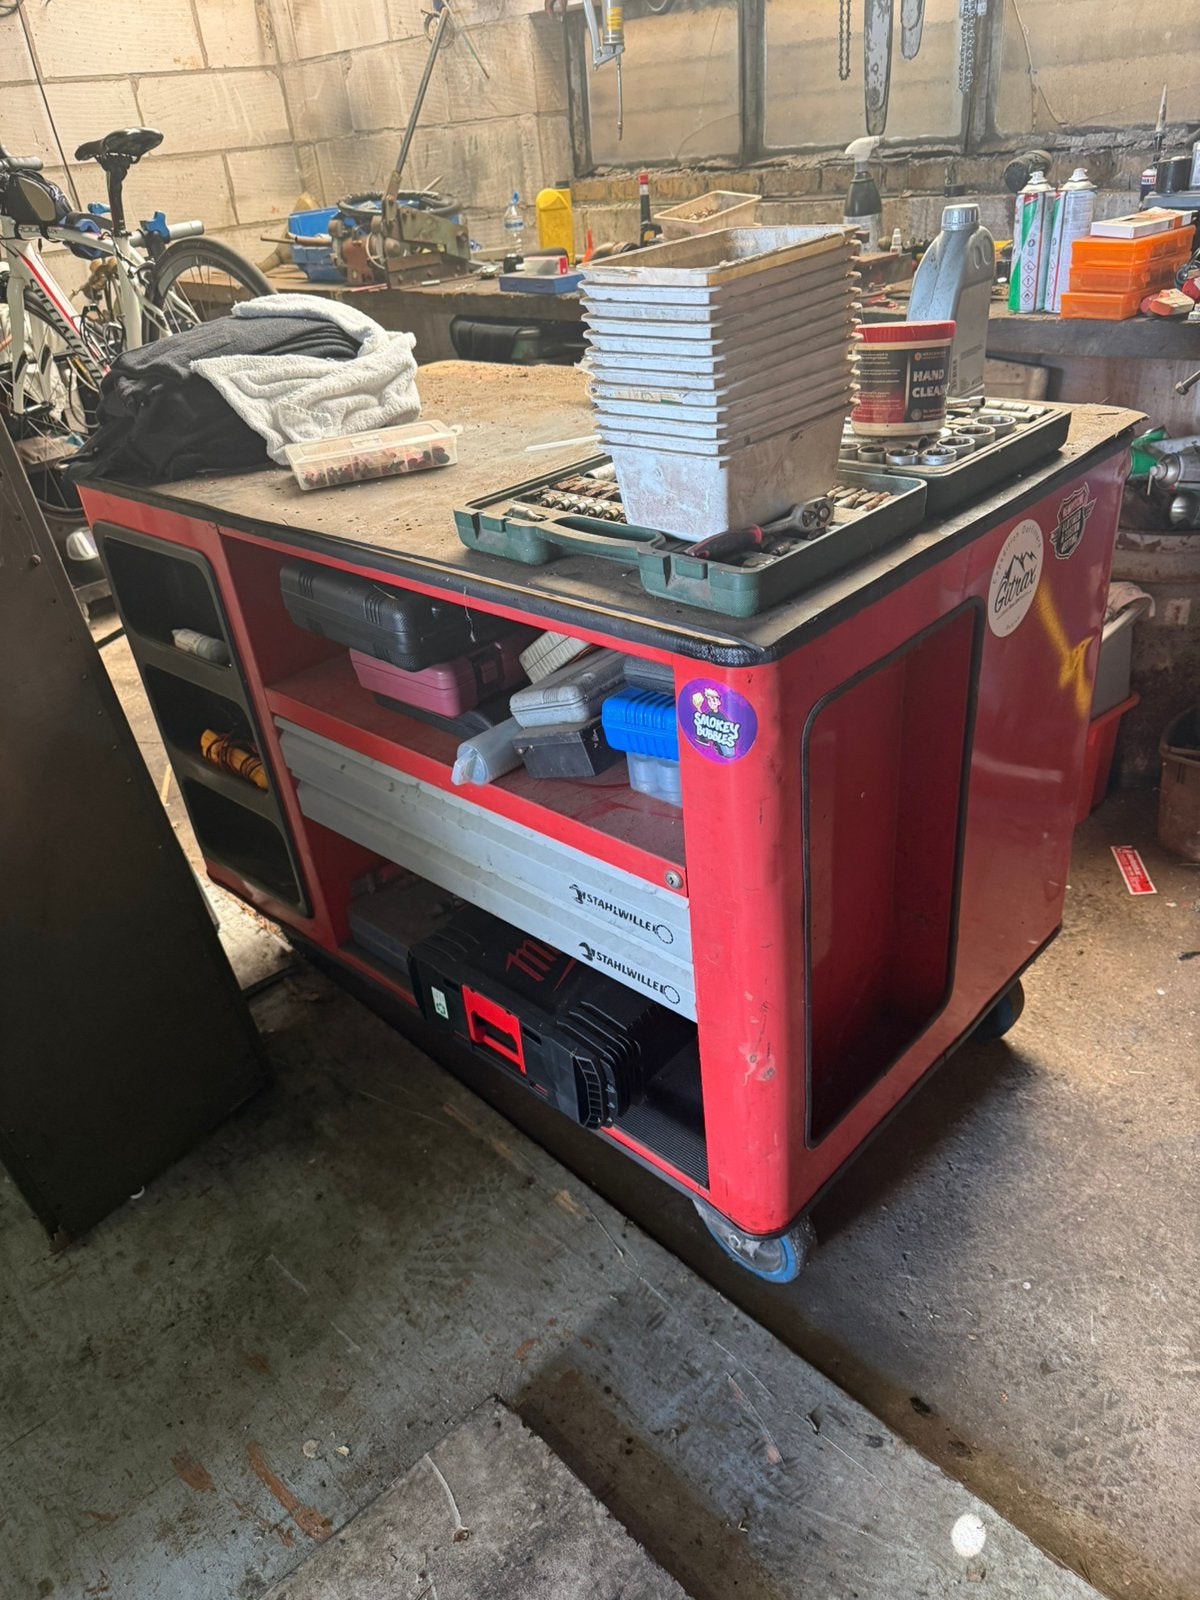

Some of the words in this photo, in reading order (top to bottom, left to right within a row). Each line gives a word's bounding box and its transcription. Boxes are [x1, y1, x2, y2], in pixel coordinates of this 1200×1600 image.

[913, 369, 945, 382] HAND
[694, 711, 740, 740] SMOKEY
[696, 725, 736, 747] BUBBLES
[586, 894, 655, 932] STAHLWILLE
[596, 951, 660, 992] STAHLWILLE
